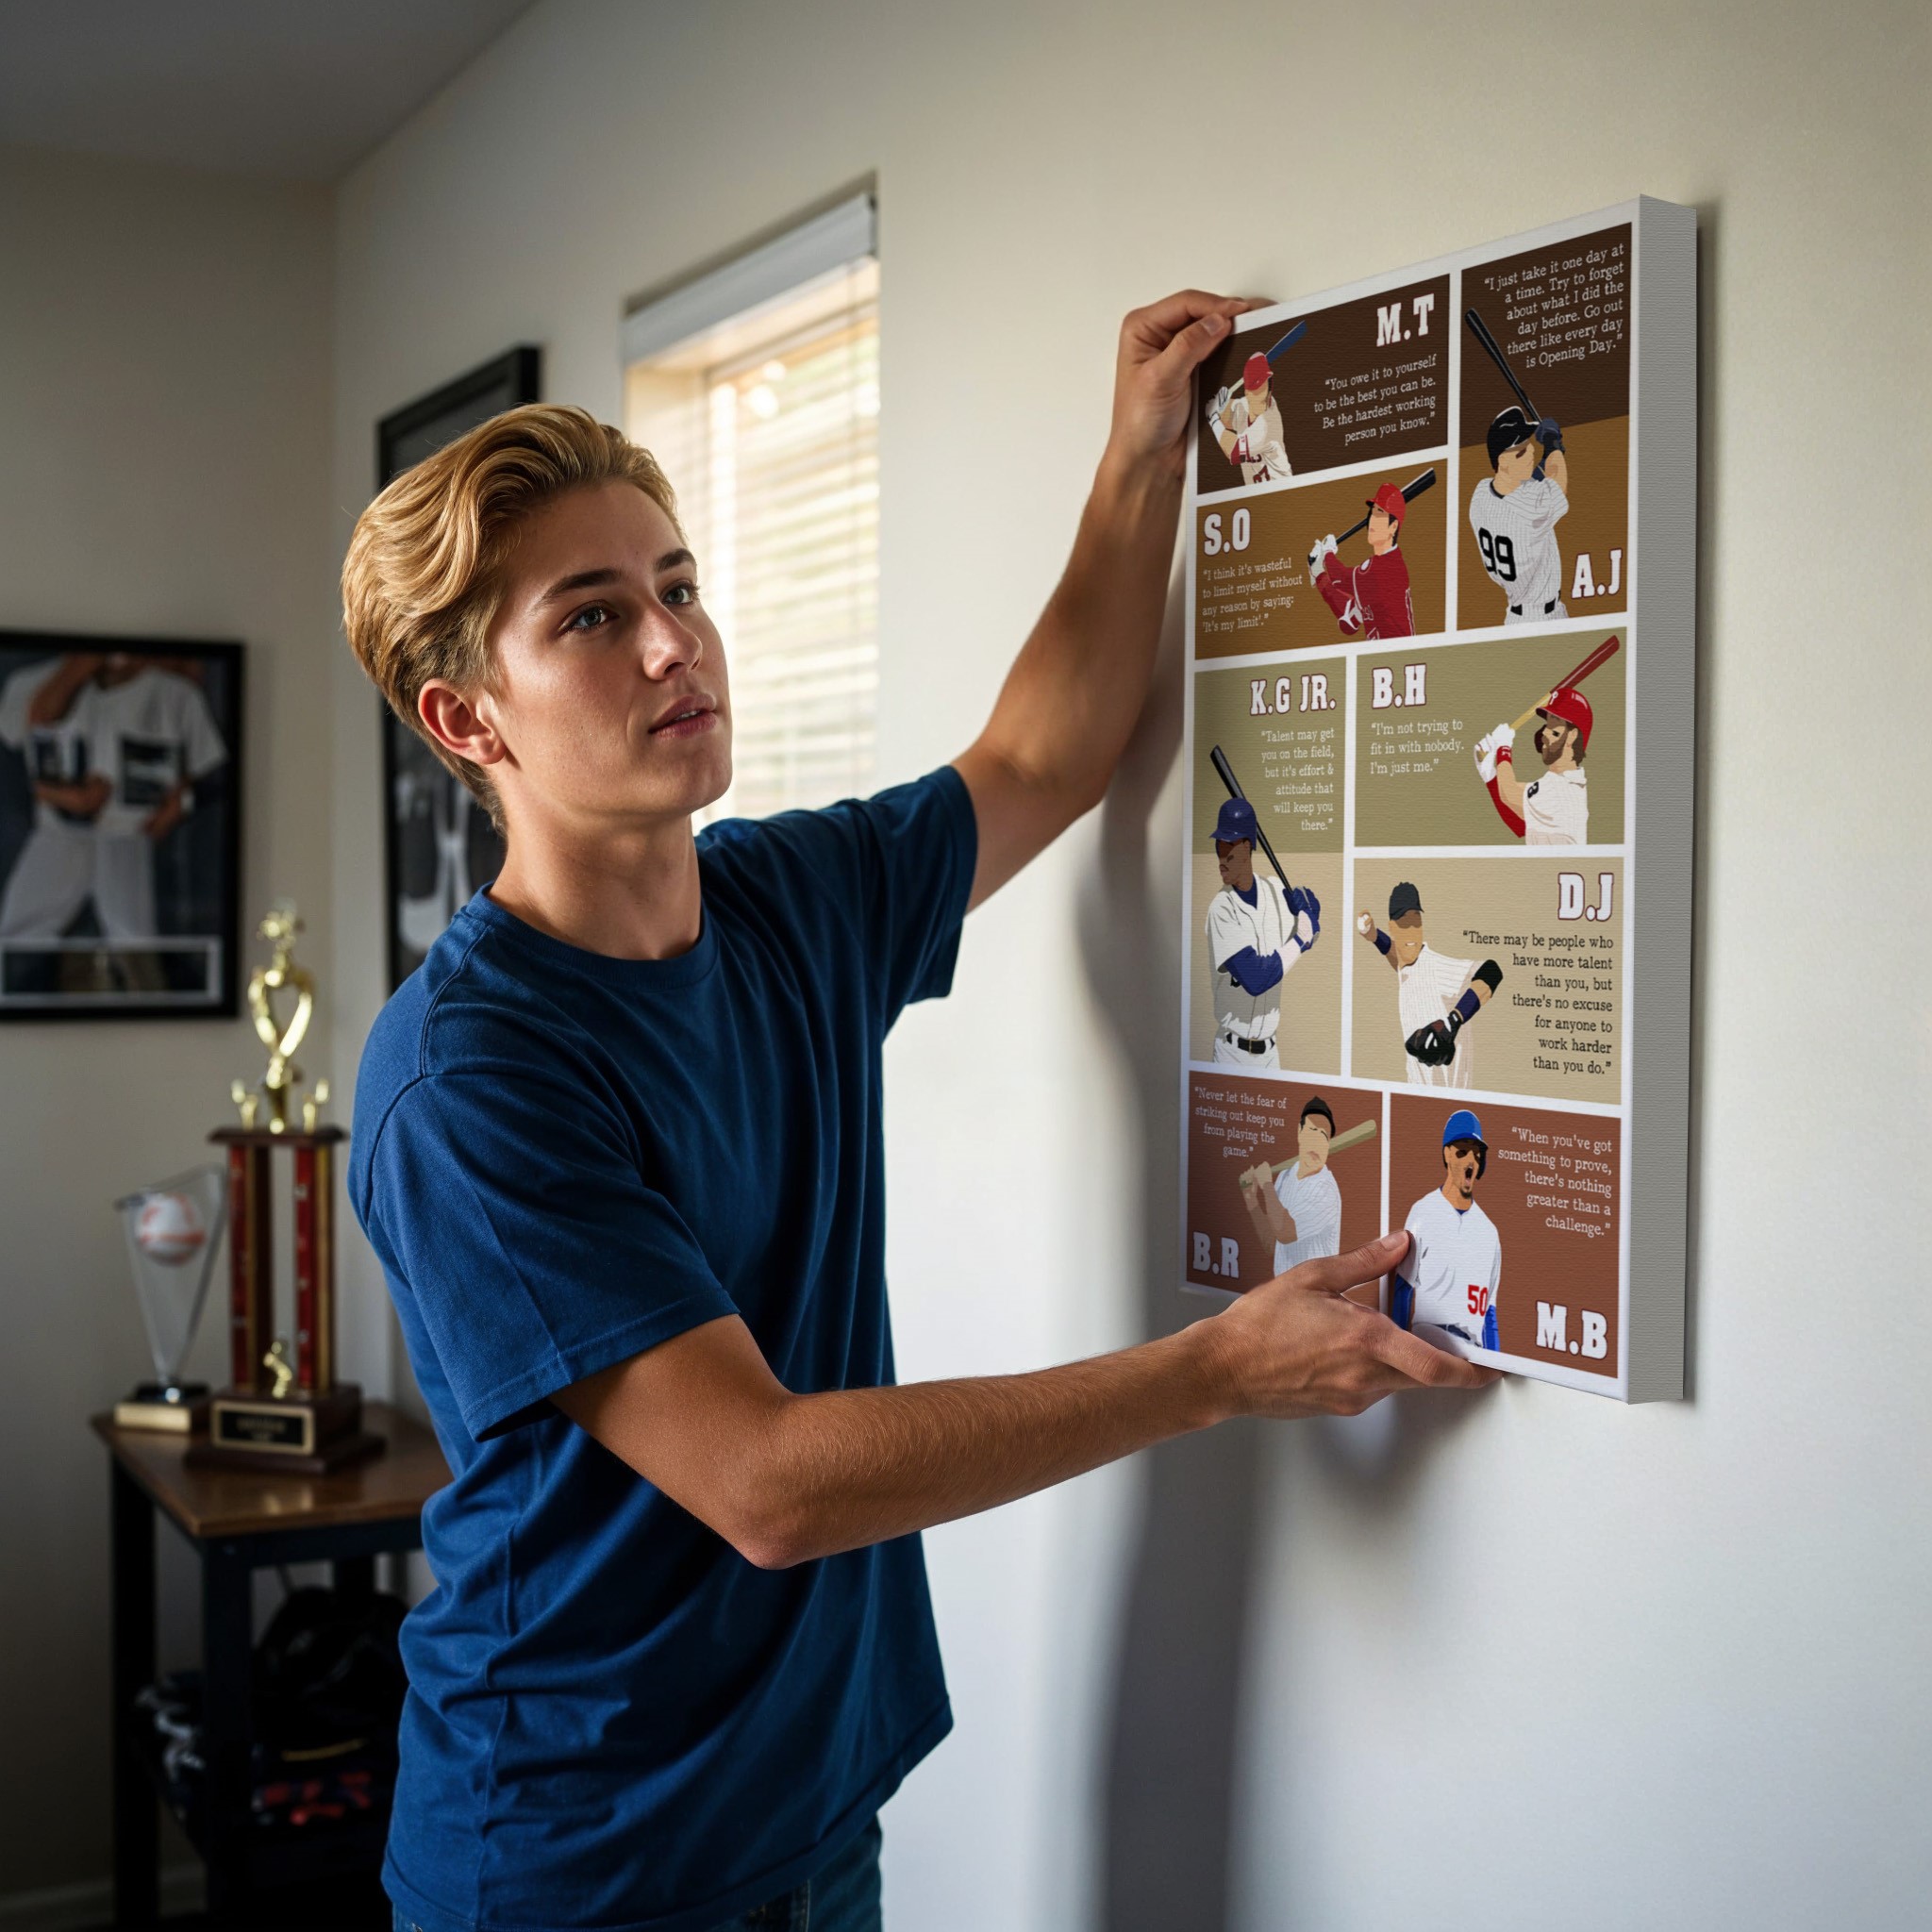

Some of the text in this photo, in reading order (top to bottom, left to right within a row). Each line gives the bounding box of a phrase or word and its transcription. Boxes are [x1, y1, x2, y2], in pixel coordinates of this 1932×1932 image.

[1496, 273, 1518, 291] just
[1522, 266, 1547, 281] take
[1550, 261, 1559, 274] it
[1562, 258, 1583, 271] one
[1586, 250, 1608, 264] day
[1611, 243, 1624, 257] at
[1505, 262, 1624, 304] a time. Try to forget
[1507, 281, 1624, 321] about what I did the
[1376, 293, 1434, 347] M.T
[1518, 299, 1623, 335] day before. Go out
[1507, 319, 1623, 355] there like every day
[1526, 356, 1537, 368] is
[1539, 346, 1586, 367] Opening
[1351, 375, 1370, 386] owe
[1372, 369, 1380, 380] it
[1383, 368, 1393, 377] to
[1395, 354, 1438, 378] yourself
[1314, 376, 1436, 412] to be the best you can be.
[1323, 395, 1436, 429] Be the hardest working
[1345, 428, 1377, 446] person
[1379, 425, 1397, 438] you
[1204, 507, 1251, 557] S.O
[1478, 527, 1517, 581] 99
[1213, 567, 1236, 579] think
[1238, 564, 1253, 576] it's
[1254, 558, 1292, 573] wasteful
[1571, 548, 1623, 599] A.J
[1213, 585, 1234, 597] limit
[1237, 578, 1267, 595] myself
[1269, 575, 1303, 588] without
[1203, 594, 1294, 617] any reason by saying:
[1221, 622, 1235, 632] my
[1250, 674, 1337, 716] K.G JR.
[1372, 663, 1426, 708] B.H
[1297, 731, 1318, 742] may
[1320, 728, 1335, 742] get
[1397, 723, 1414, 734] not
[1417, 720, 1449, 736] trying
[1452, 719, 1463, 730] to
[1261, 745, 1335, 763] you on the field,
[1371, 739, 1465, 755] fit in with nobody.
[1265, 763, 1334, 778] but it's effort &
[1371, 762, 1389, 774] I'm
[1390, 762, 1410, 776] just
[1275, 783, 1334, 795] attitude that
[1274, 802, 1334, 816] will keep you
[1557, 873, 1614, 922] D.J
[1504, 936, 1528, 949] may
[1532, 934, 1545, 946] be
[1548, 935, 1586, 951] people
[1589, 936, 1614, 949] who
[1512, 953, 1613, 970] have more talent
[1535, 974, 1613, 992] than you, but
[1512, 993, 1613, 1012] there's no excuse
[1535, 1015, 1613, 1034] for anyone to
[1539, 1038, 1612, 1054] work harder
[1533, 1057, 1559, 1070] than
[1563, 1062, 1584, 1074] you
[1226, 1091, 1238, 1103] let
[1240, 1093, 1255, 1106] the
[1257, 1094, 1275, 1108] fear
[1277, 1098, 1288, 1109] of
[1194, 1107, 1285, 1128] striking out keep you
[1204, 1124, 1275, 1145] from playing the
[1553, 1134, 1591, 1150] you've
[1593, 1141, 1612, 1155] got
[1498, 1150, 1612, 1175] something to prove,
[1524, 1171, 1612, 1199] there's nothing
[1526, 1194, 1611, 1216] greater than a
[1192, 1231, 1240, 1279] B.R
[1467, 1284, 1489, 1317] 50
[1536, 1300, 1607, 1360] M.B
